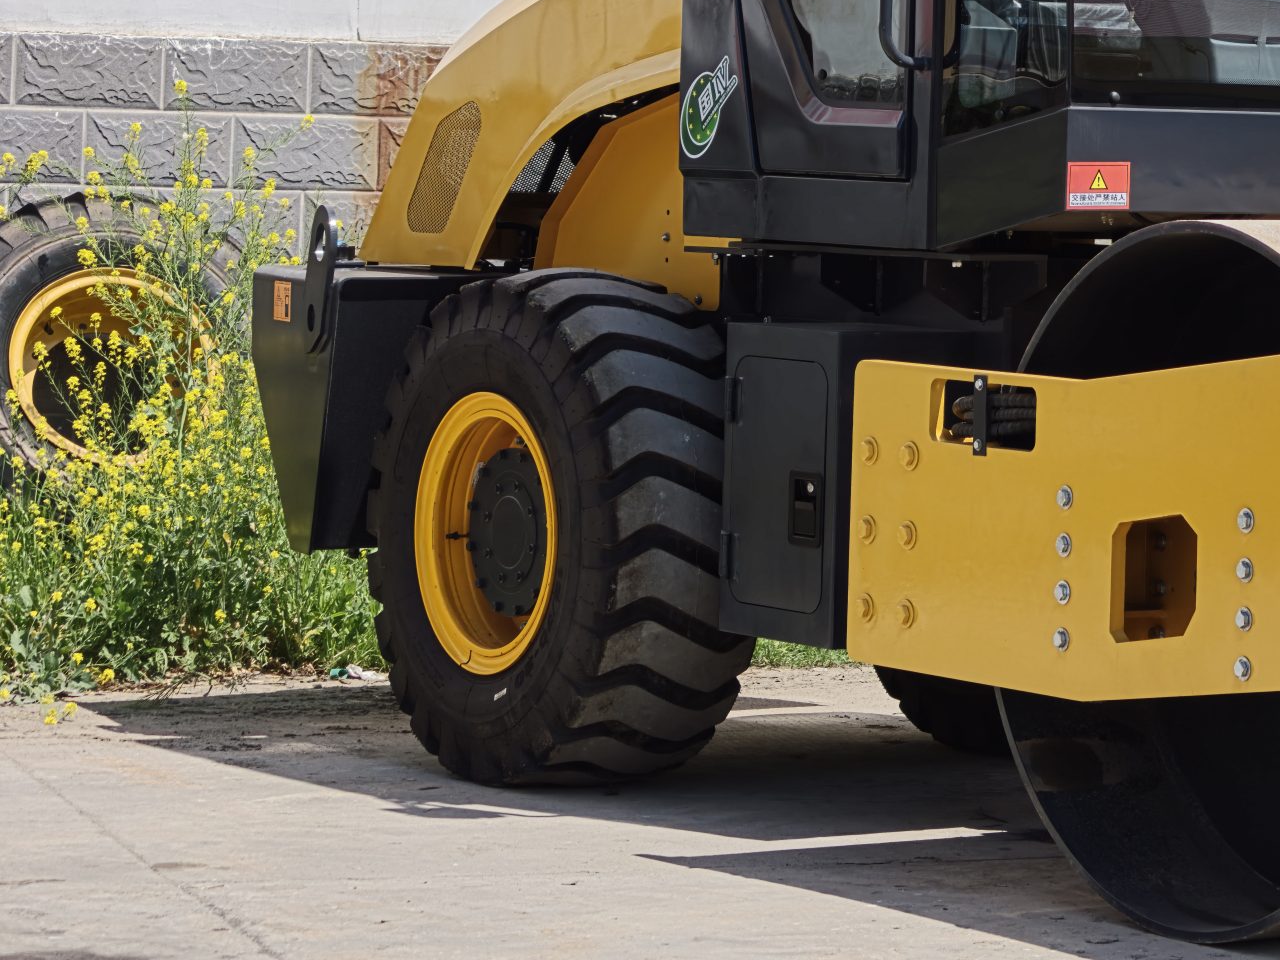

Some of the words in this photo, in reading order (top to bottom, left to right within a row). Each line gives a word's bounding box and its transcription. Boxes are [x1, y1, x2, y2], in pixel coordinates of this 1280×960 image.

[1071, 194, 1126, 202] 交接处严禁站人
